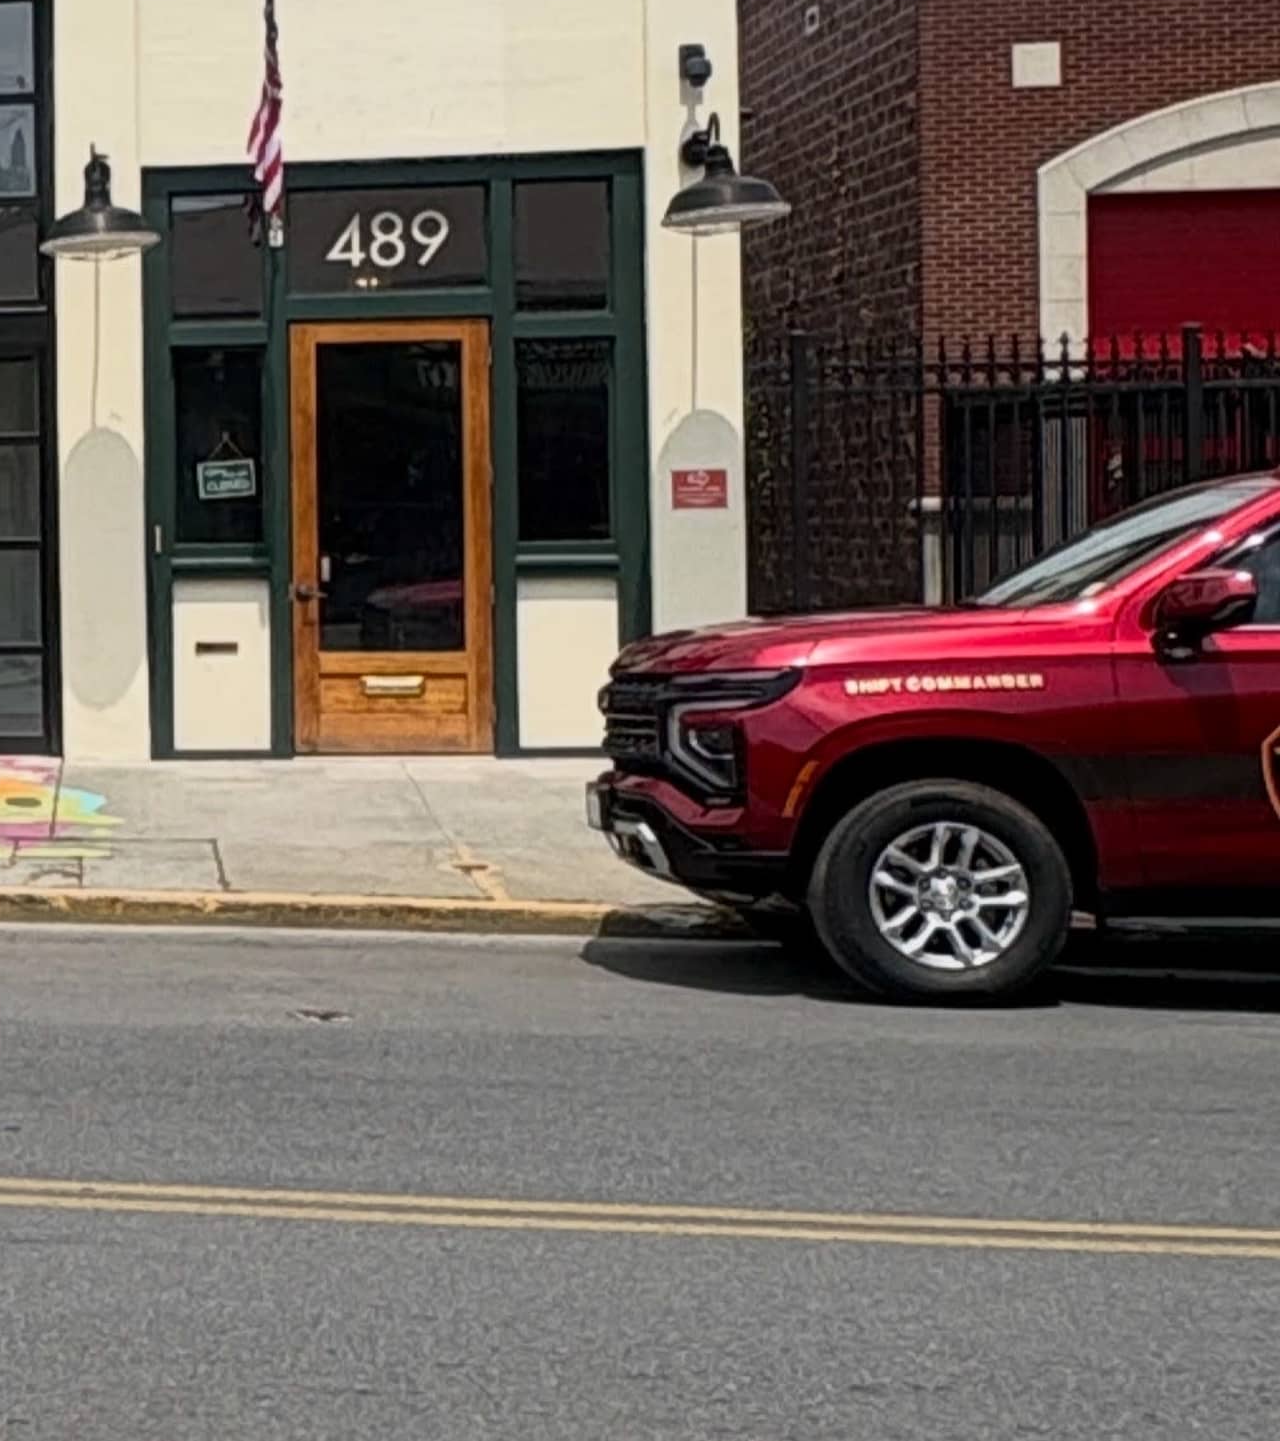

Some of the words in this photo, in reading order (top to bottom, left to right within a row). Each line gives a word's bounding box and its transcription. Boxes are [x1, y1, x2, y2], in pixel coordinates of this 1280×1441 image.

[325, 210, 449, 267] 489
[845, 678, 902, 694] SHIFT
[905, 674, 1044, 693] COMMANDER
